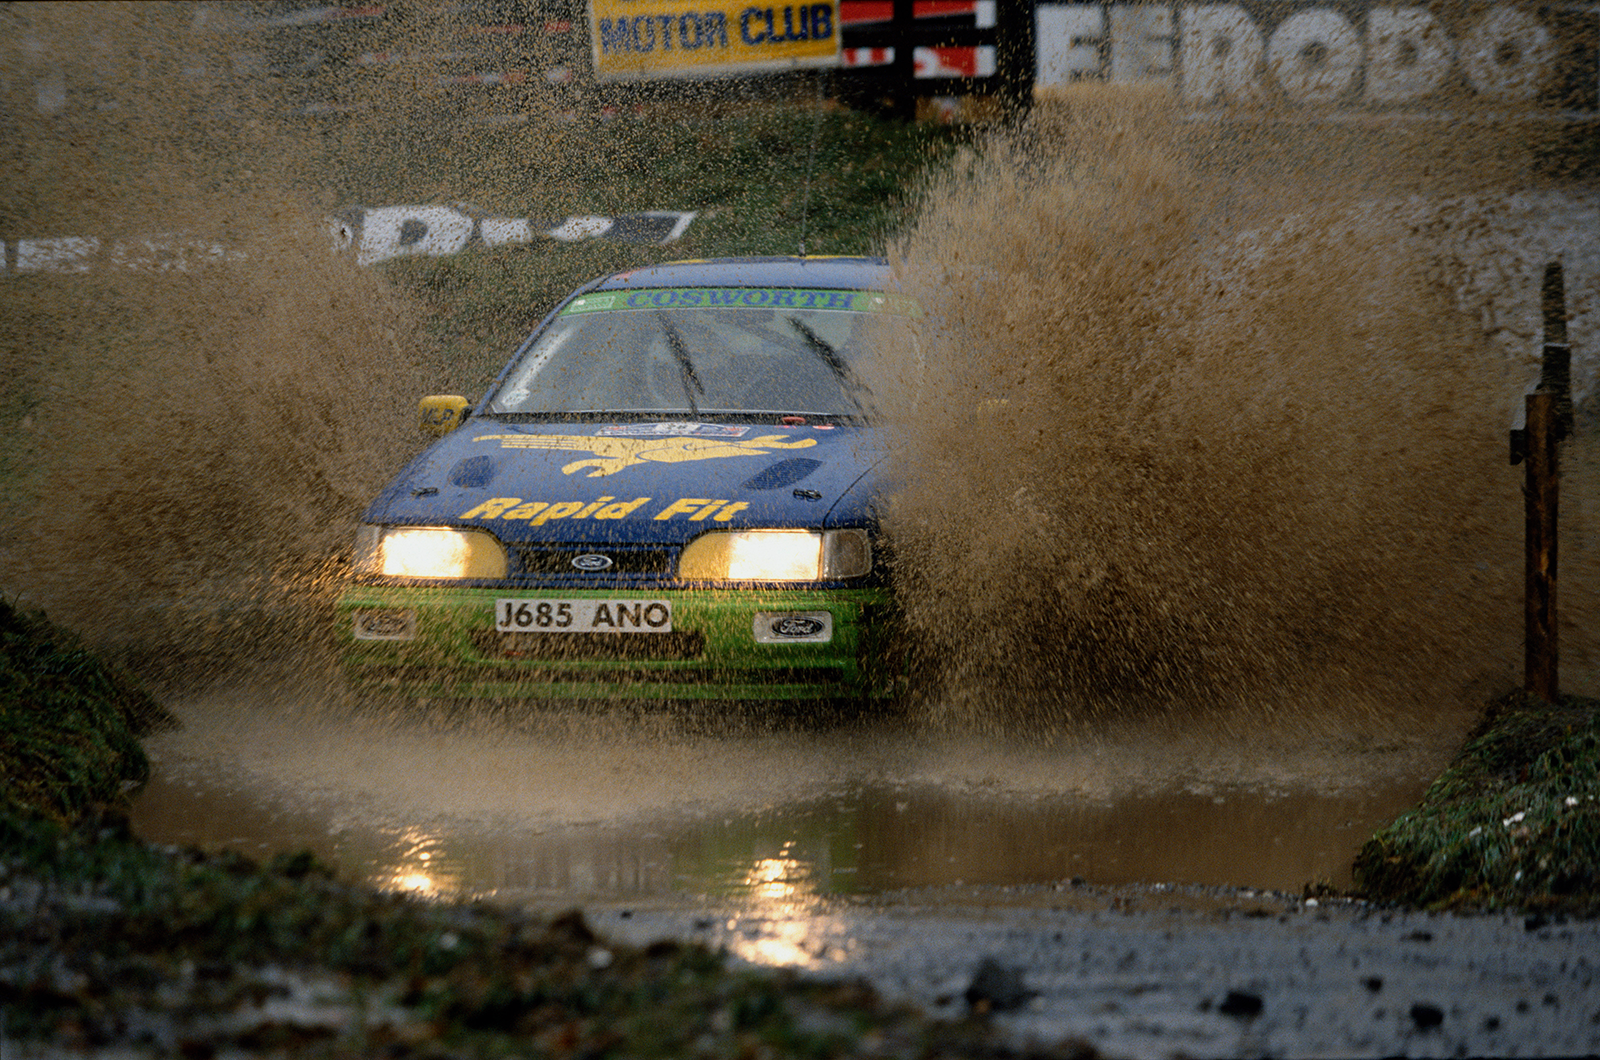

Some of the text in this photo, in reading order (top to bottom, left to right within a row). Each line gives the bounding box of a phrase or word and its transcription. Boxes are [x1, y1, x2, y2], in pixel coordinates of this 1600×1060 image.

[600, 4, 833, 54] MOTOR CLUB
[626, 288, 859, 309] COSWORTH
[458, 496, 749, 526] Rapid Fit
[499, 602, 670, 628] J685 ANO
